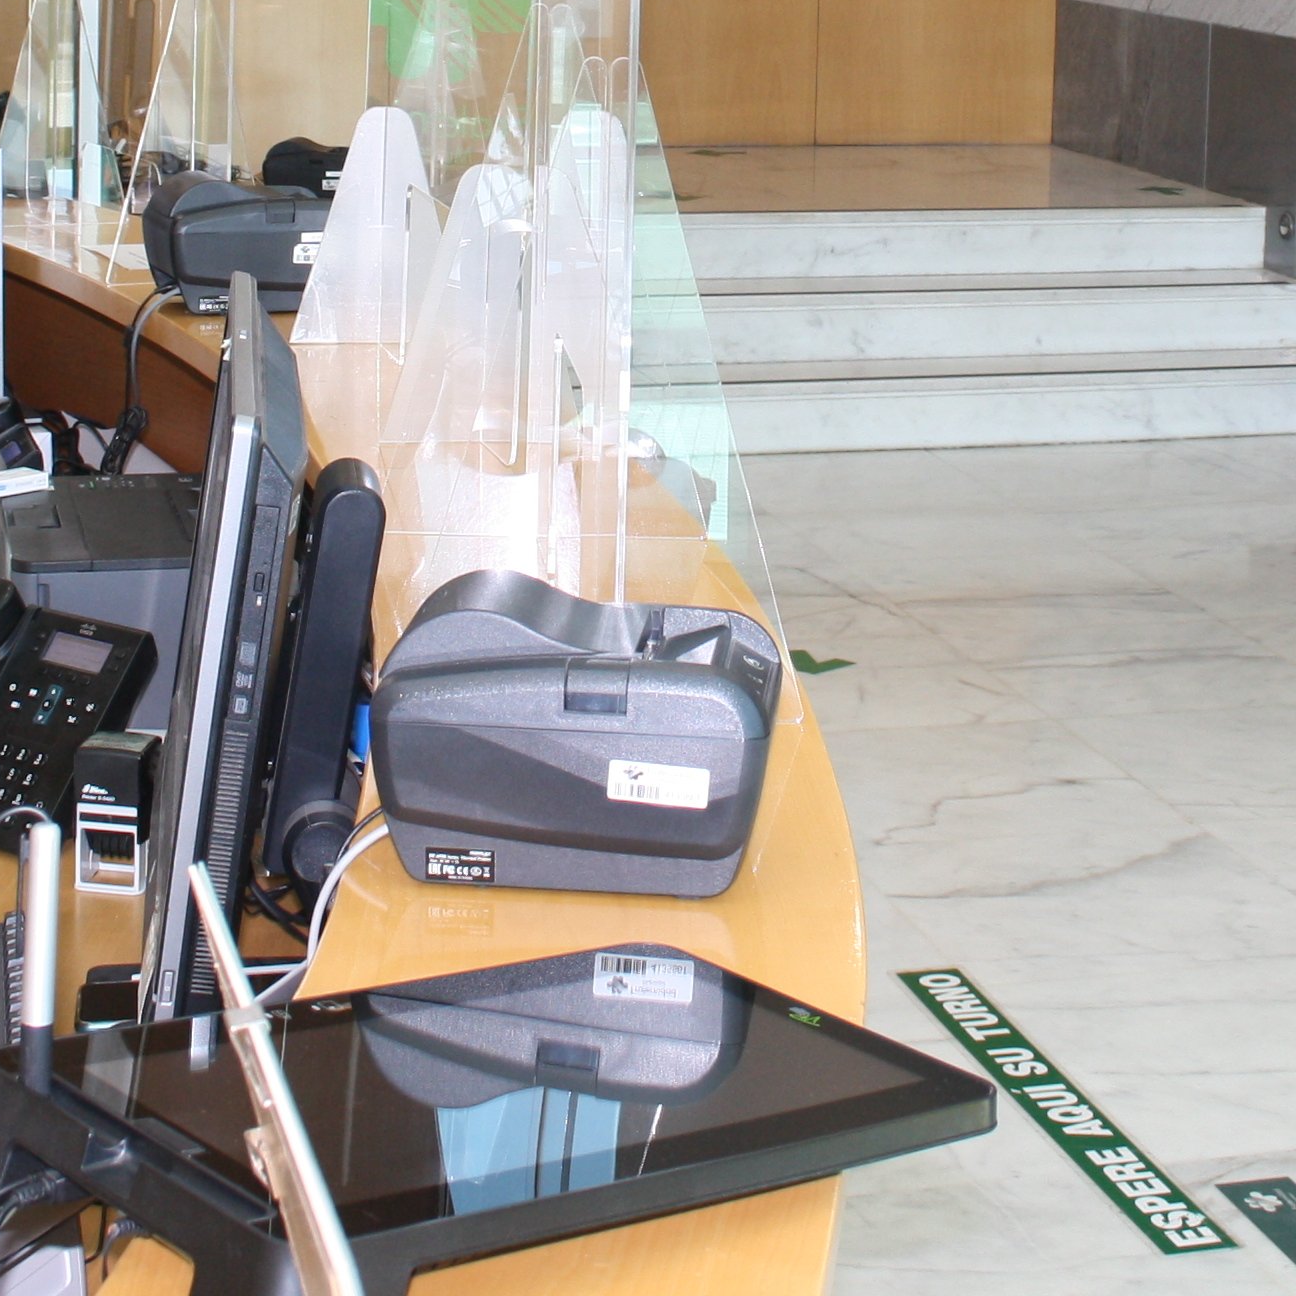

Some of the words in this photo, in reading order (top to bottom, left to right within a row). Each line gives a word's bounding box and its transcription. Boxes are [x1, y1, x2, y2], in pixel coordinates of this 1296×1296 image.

[919, 972, 1011, 1042] TURNO
[987, 1047, 1048, 1077] SU
[1010, 1084, 1114, 1136] AQUÍ
[1084, 1146, 1222, 1248] ESPERE
